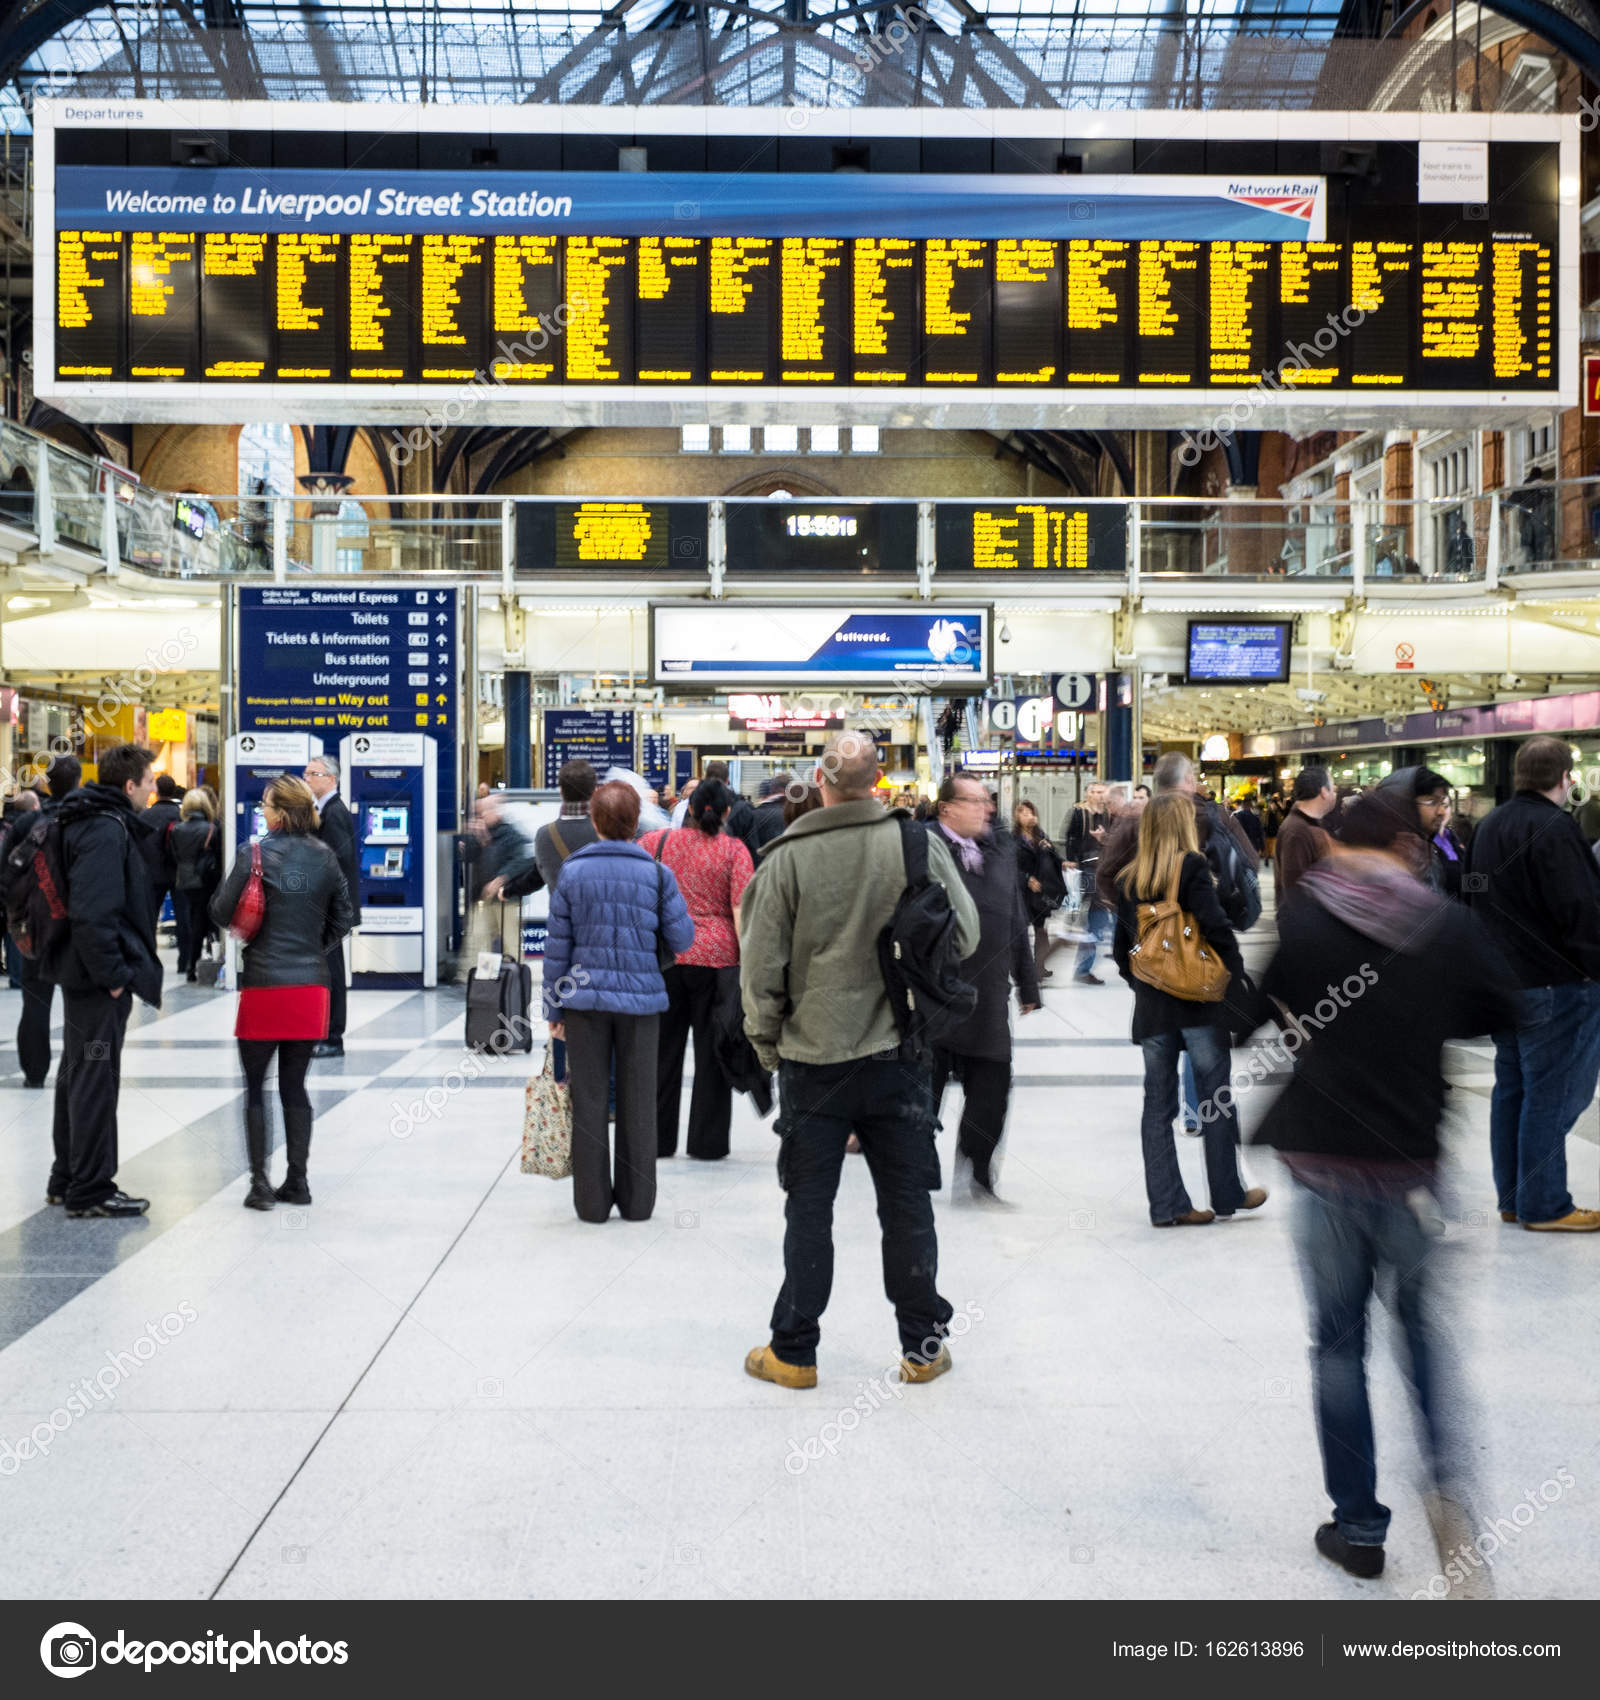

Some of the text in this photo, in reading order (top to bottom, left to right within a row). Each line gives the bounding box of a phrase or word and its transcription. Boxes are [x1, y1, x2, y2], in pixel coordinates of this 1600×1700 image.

[65, 106, 144, 122] Departures
[107, 188, 572, 221] Welcome to Liverpool Street Station
[312, 591, 399, 605] Stansted Express
[351, 612, 389, 625] Toilets
[266, 632, 307, 645] Tickets
[310, 632, 320, 645] &
[325, 652, 389, 666] Bus station
[313, 672, 389, 688] Underground
[338, 694, 389, 708] Way out
[338, 714, 389, 728] Way out
